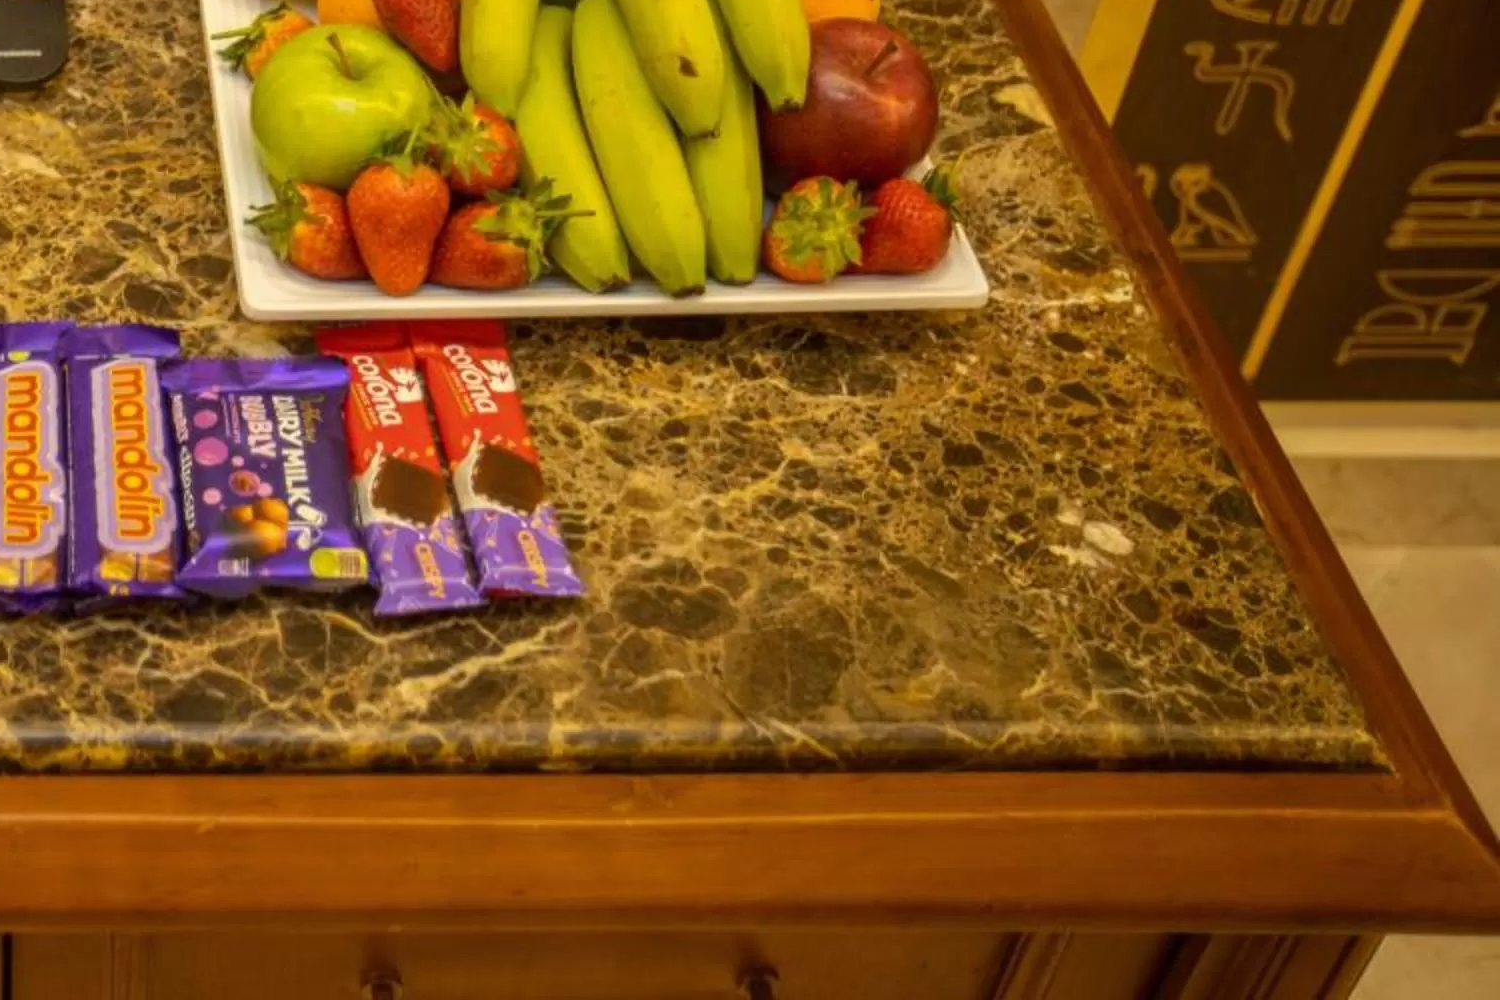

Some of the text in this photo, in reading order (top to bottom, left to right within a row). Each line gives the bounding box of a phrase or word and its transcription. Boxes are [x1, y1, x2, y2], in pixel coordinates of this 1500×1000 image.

[4, 374, 51, 544] mandolin
[110, 366, 162, 538] mandolin
[281, 447, 312, 504] MILK
